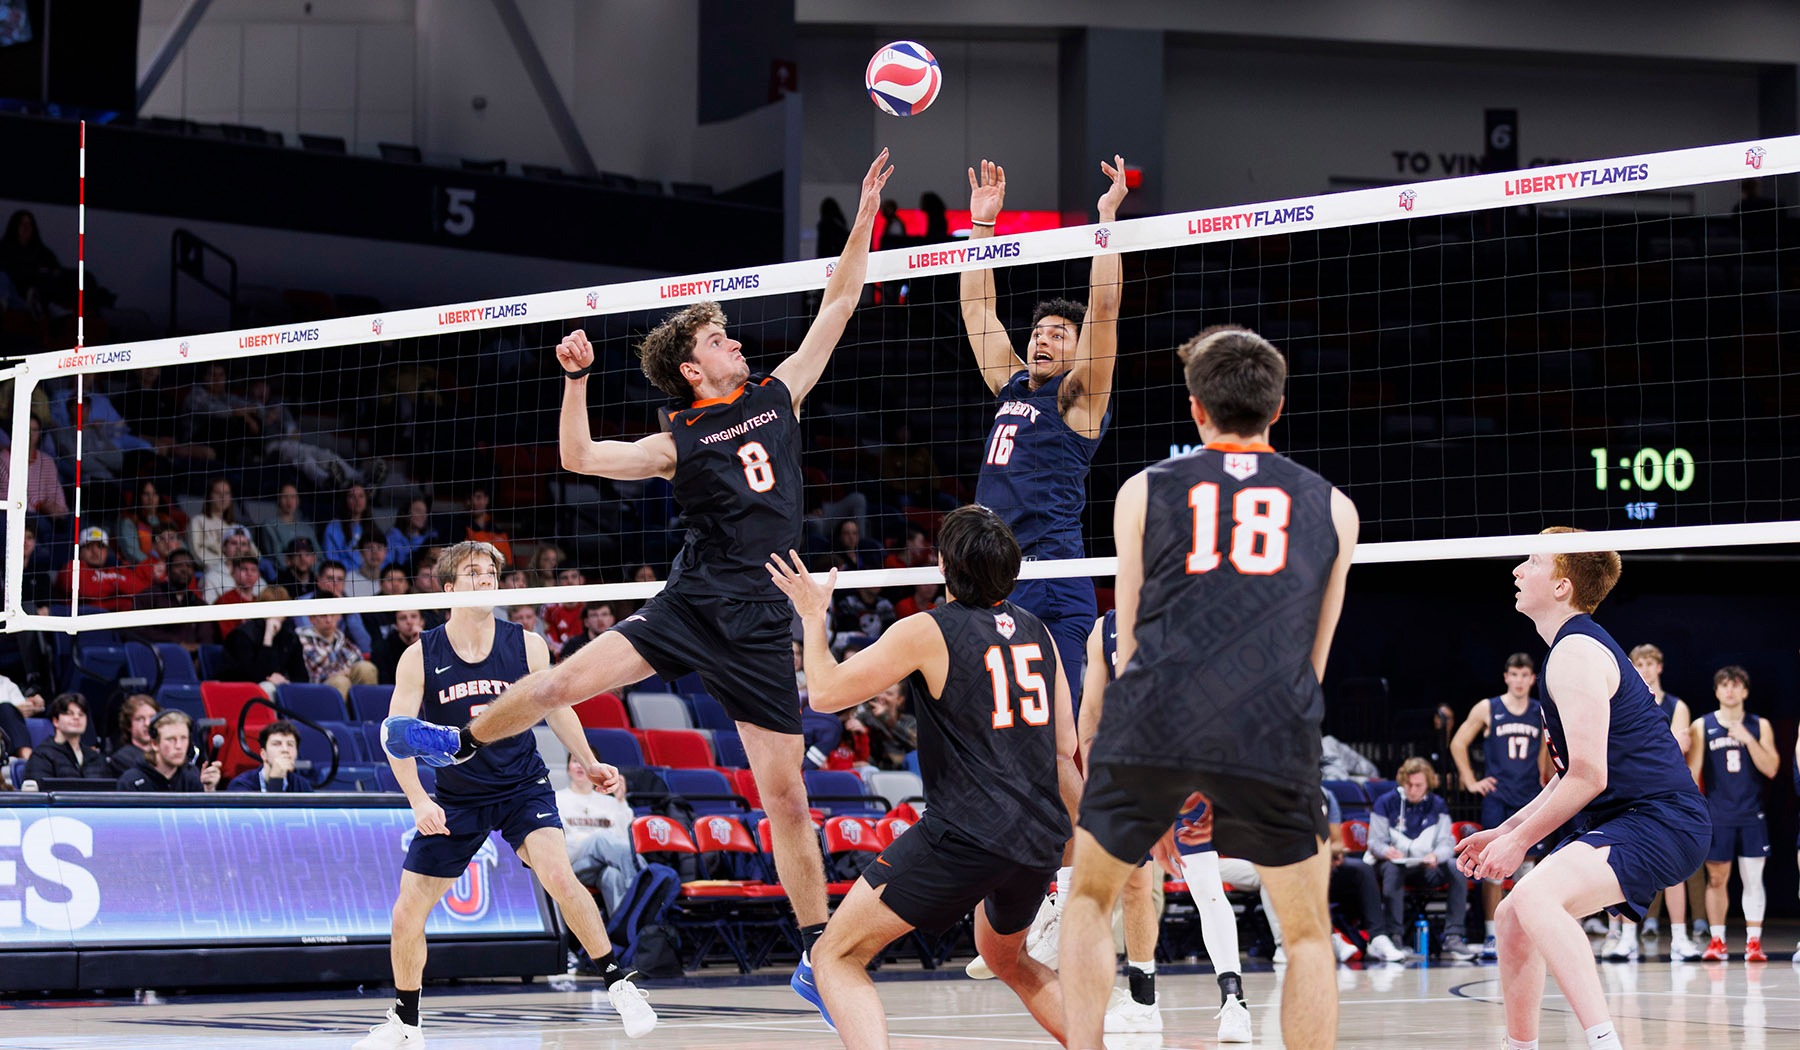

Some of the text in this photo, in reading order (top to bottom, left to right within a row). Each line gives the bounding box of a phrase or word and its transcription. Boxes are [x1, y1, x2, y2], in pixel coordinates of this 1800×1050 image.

[1490, 124, 1512, 149] 6
[1392, 152, 1431, 174] TO
[444, 188, 476, 236] 5
[58, 350, 132, 369] LIBERTYFLAMES
[239, 328, 319, 349] LIBERTYFLAMES
[438, 303, 527, 325] LIBERTYFLAMES
[660, 274, 760, 299] LIBERTYFLAMES
[908, 242, 1021, 269] LIBERTYFLAMES
[1188, 205, 1314, 235] LIBERTYFLAMES
[1504, 163, 1649, 196] LIBERTYFLAMES
[745, 409, 778, 431] TECH
[986, 424, 1019, 466] 16
[736, 441, 776, 493] 8
[1591, 447, 1695, 491] 1:00
[1185, 480, 1292, 576] 18
[1624, 502, 1659, 520] 1ST
[983, 641, 1051, 730] 15
[1508, 736, 1529, 759] 17
[1726, 750, 1741, 772] 8
